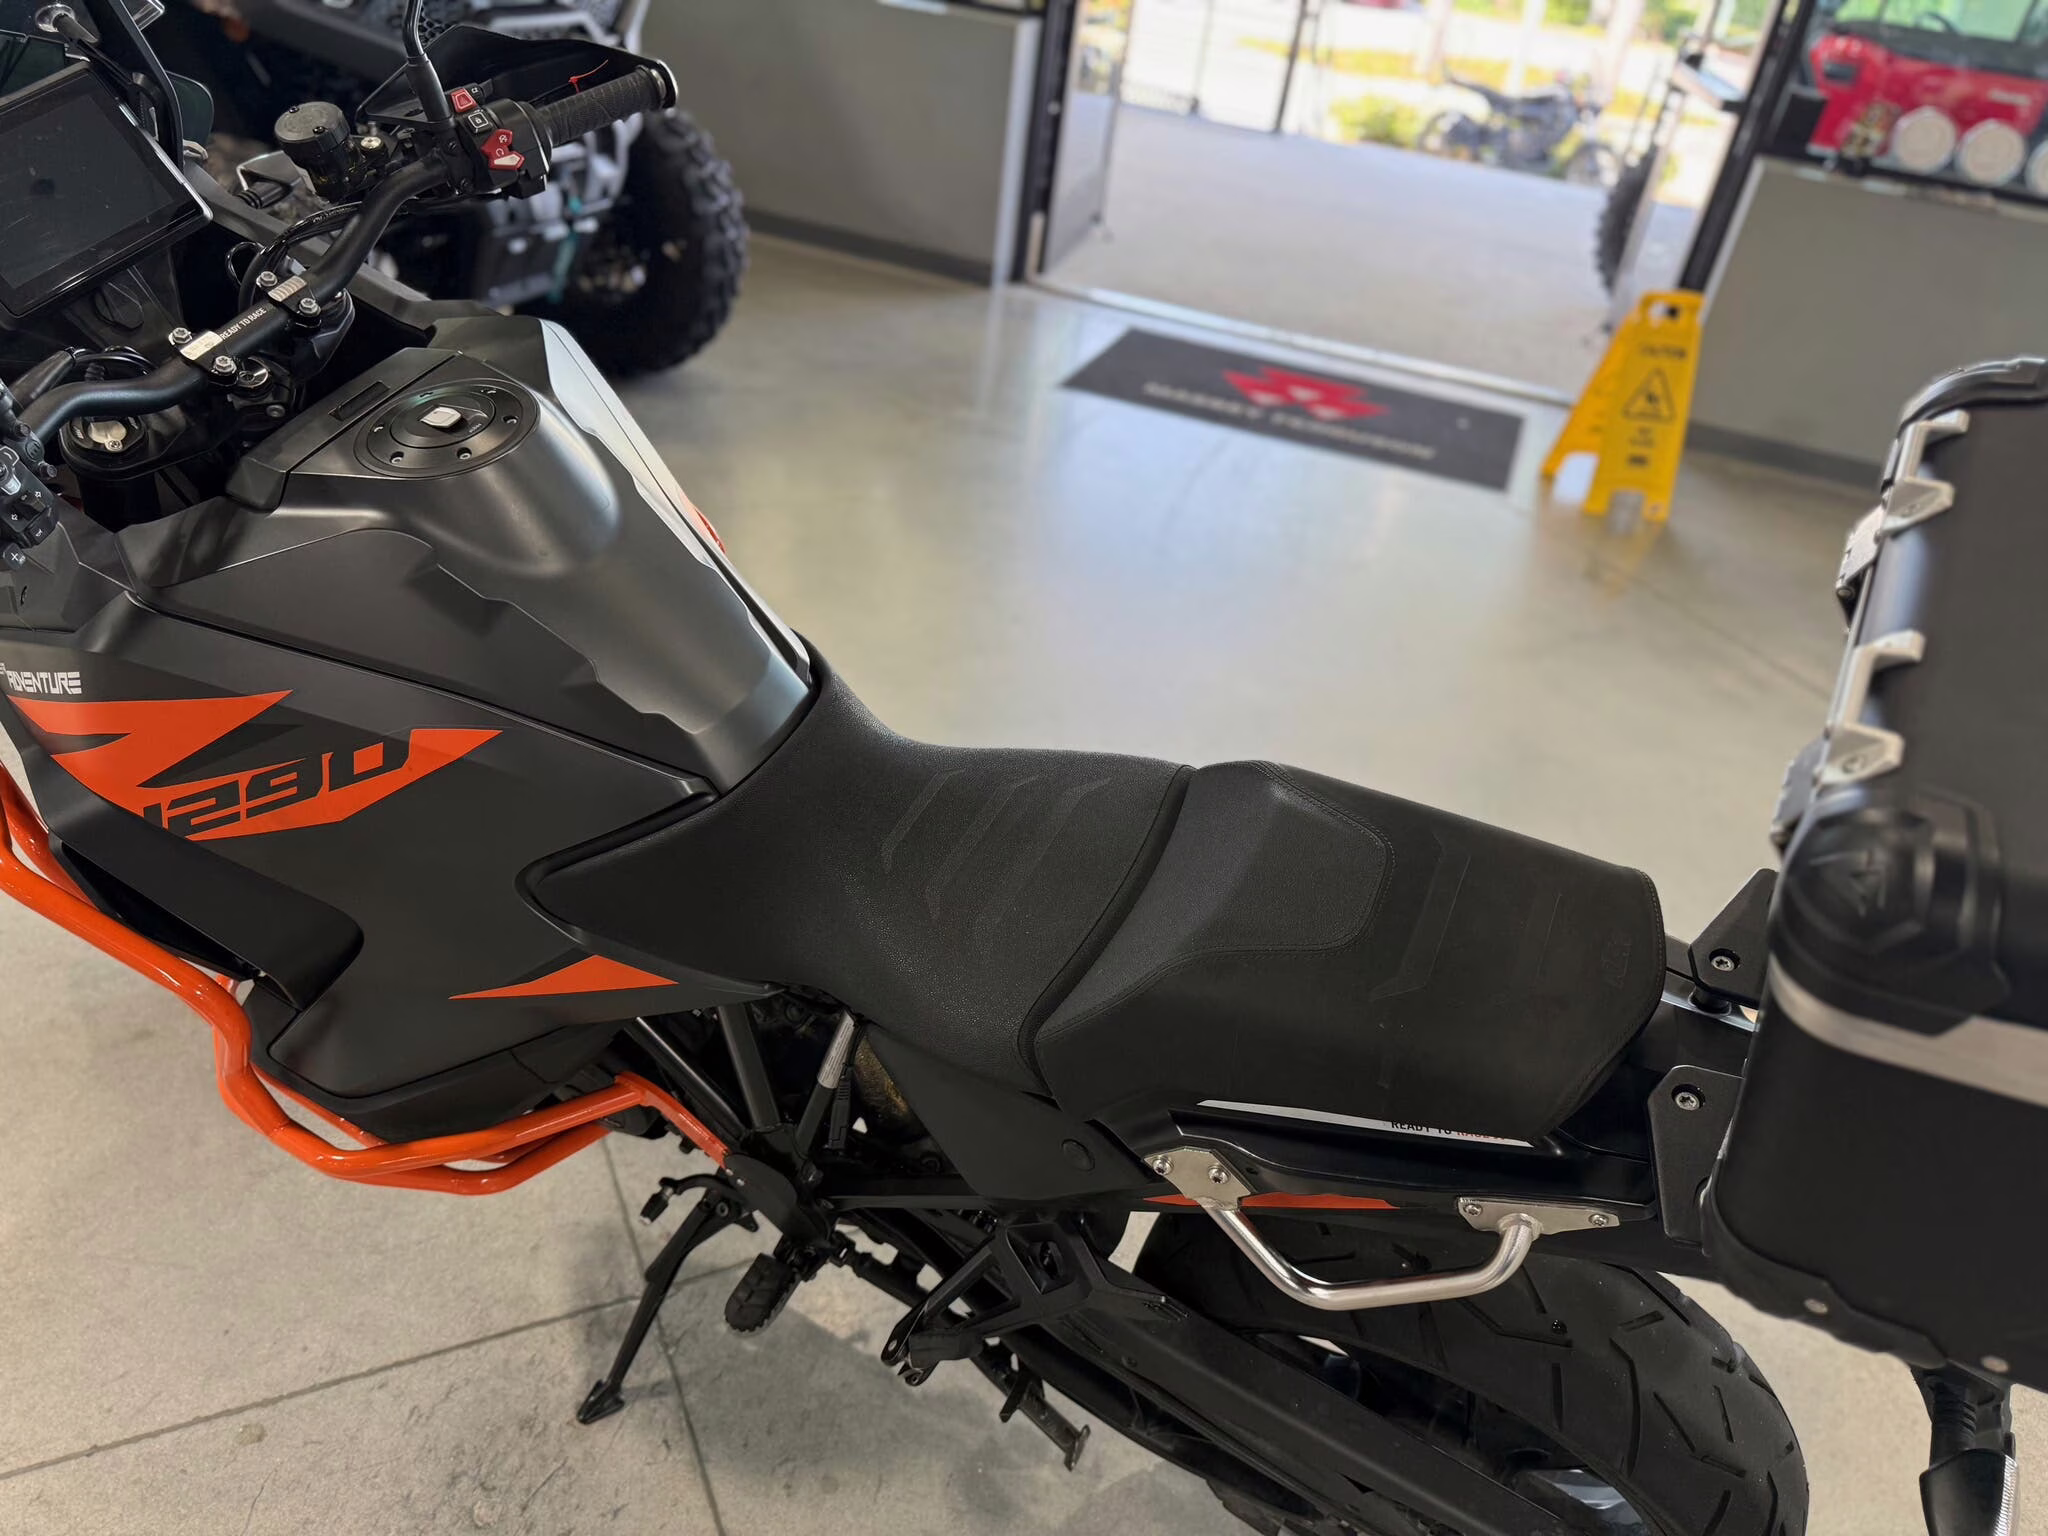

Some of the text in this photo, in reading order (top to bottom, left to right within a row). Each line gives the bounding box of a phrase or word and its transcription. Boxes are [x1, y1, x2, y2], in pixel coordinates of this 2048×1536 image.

[219, 308, 266, 340] READY TO RACE
[6, 670, 82, 695] ADVENTURE
